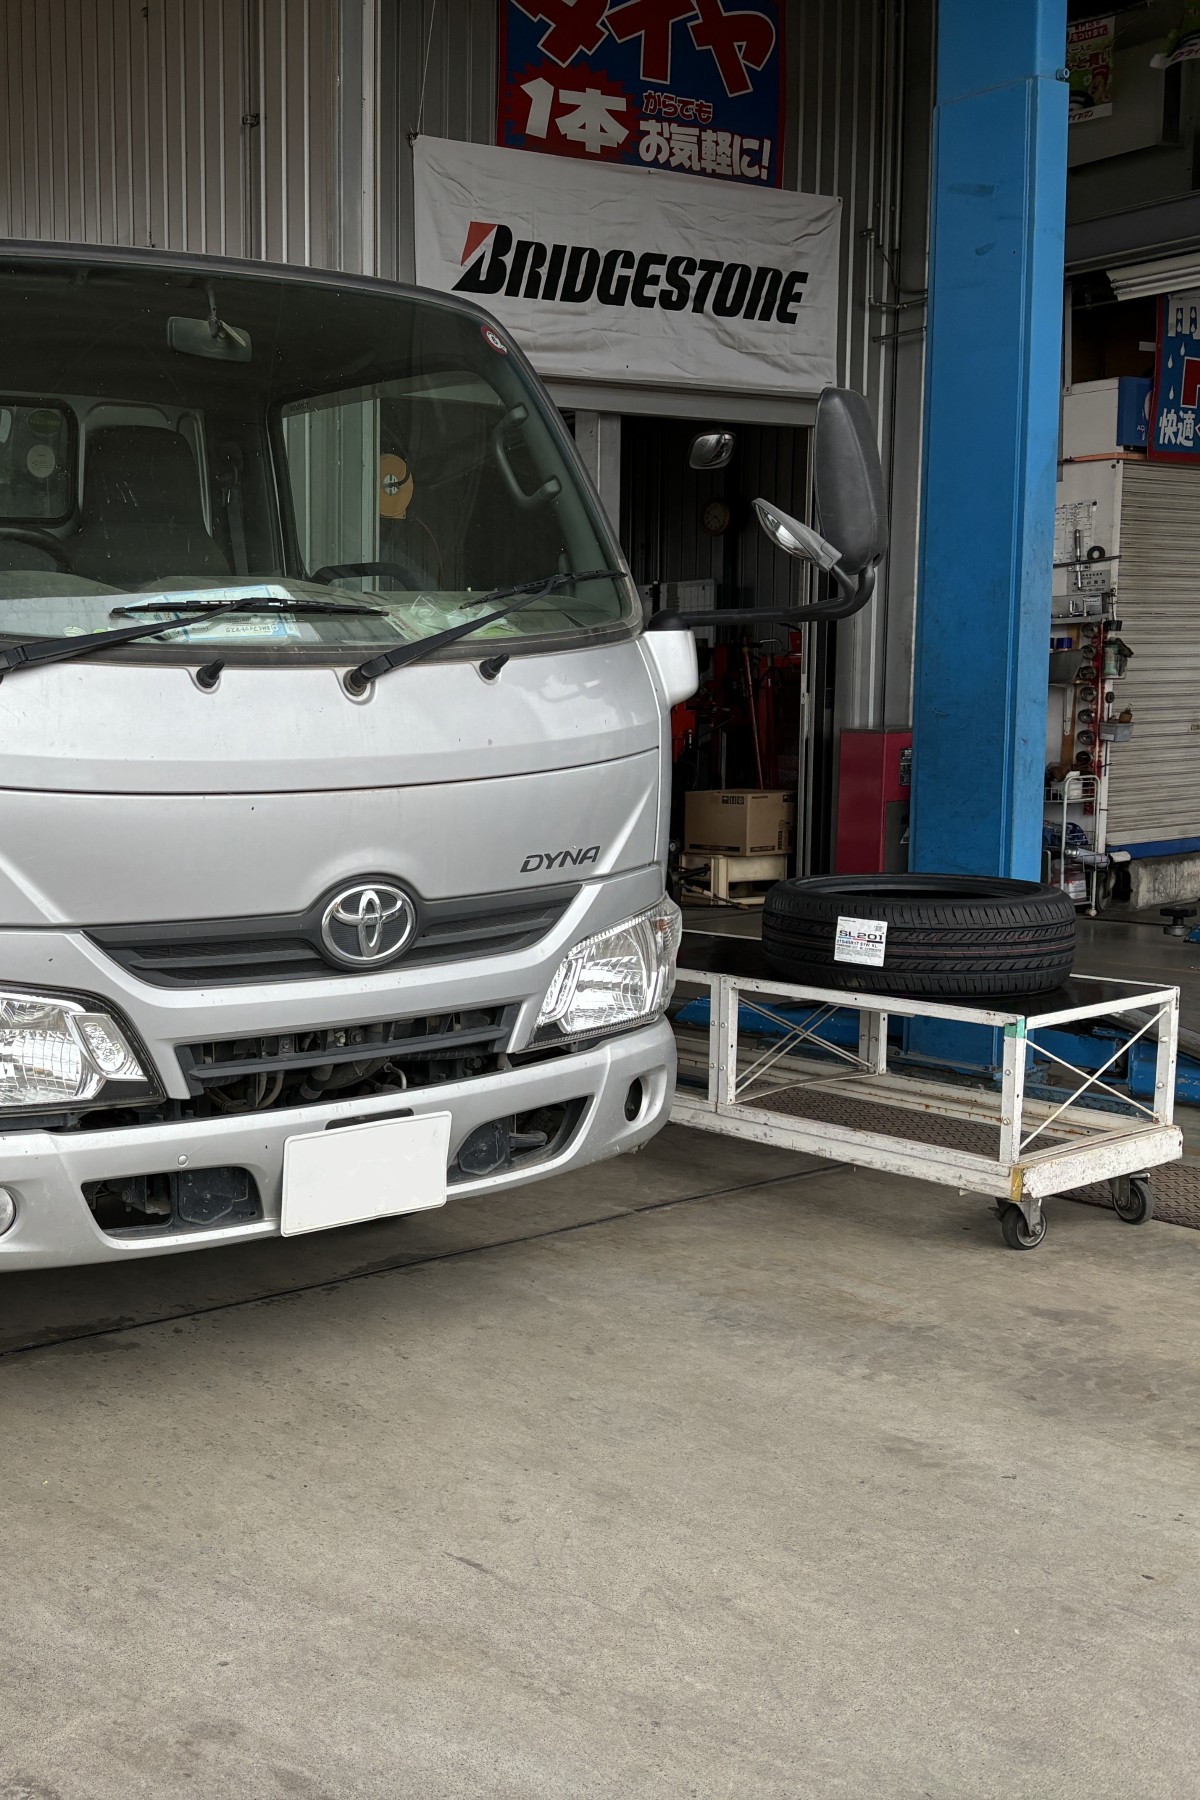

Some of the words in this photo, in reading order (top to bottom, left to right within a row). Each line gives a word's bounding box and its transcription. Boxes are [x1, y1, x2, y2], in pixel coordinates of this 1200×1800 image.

[510, 0, 776, 97] タイヤ
[520, 77, 630, 154] 1本
[642, 90, 713, 124] からでも
[638, 119, 772, 180] お気軽に!
[451, 221, 809, 324] BRIDGESTONE
[1158, 407, 1196, 448] 快適
[520, 845, 601, 873] DYNA
[839, 930, 883, 941] SL201
